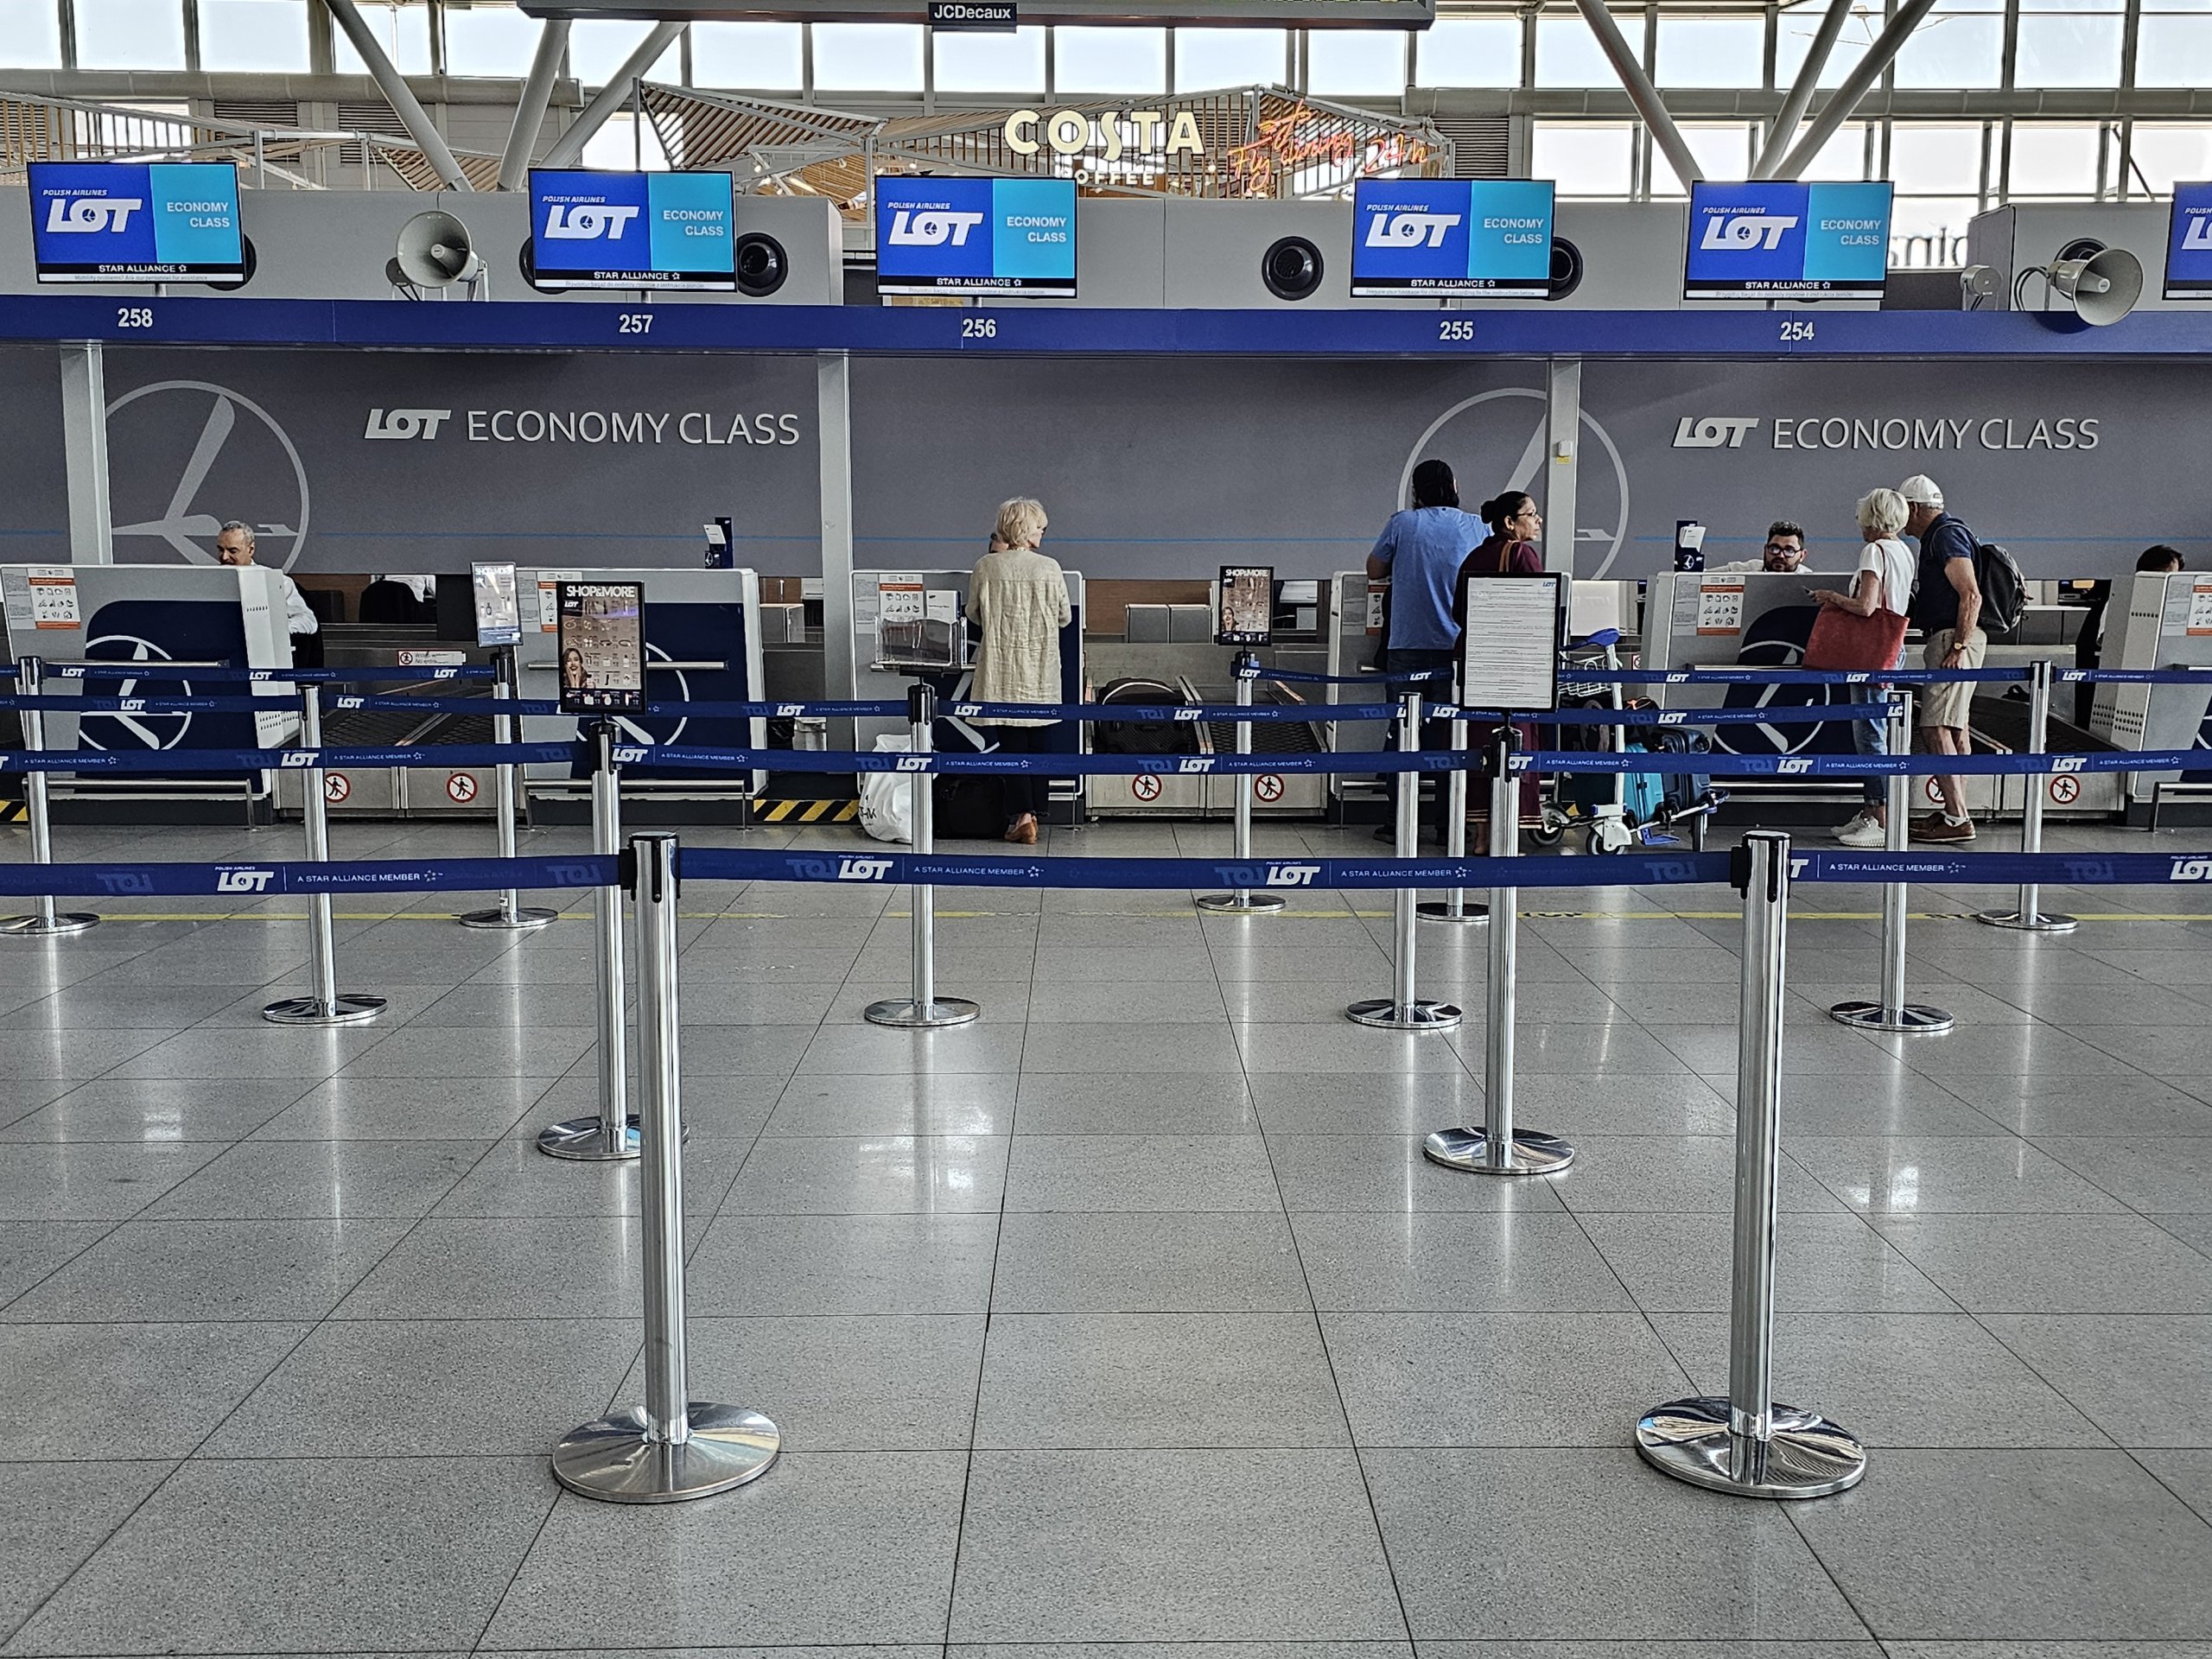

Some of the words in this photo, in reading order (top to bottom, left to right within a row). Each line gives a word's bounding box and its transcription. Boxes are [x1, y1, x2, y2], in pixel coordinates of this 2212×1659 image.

[934, 5, 1011, 19] JCDecaux
[1004, 110, 1206, 162] COSTA
[1058, 168, 1154, 186] OFFEE
[167, 201, 229, 213] ECONOMY
[46, 199, 143, 233] LOT
[663, 210, 723, 221] ECONOMY
[1007, 216, 1067, 227] ECONOMY
[189, 218, 230, 228] CLASS
[543, 205, 639, 239] LOT
[1484, 218, 1544, 229] ECONOMY
[1821, 219, 1882, 230] ECONOMY
[684, 226, 724, 236] CLASS
[887, 211, 984, 246] LOT
[1364, 213, 1462, 248] LOT
[1700, 216, 1799, 250] LOT
[1027, 232, 1066, 243] CLASS
[1503, 233, 1542, 244] CLASS
[1840, 235, 1879, 245] CLASS
[126, 264, 175, 273] ALLIANCE
[594, 271, 619, 280] STAR
[963, 278, 1011, 287] ALLIANCE
[118, 308, 154, 328] 258
[619, 315, 653, 334] 257
[963, 318, 997, 339] 256
[1440, 320, 1474, 340] 255
[1780, 321, 1815, 341] 254
[365, 409, 451, 440] LOT
[467, 410, 671, 443] ECONOMY
[678, 412, 800, 446] CLASS
[1672, 416, 1759, 448] LOT
[1773, 417, 1973, 449] ECONOMY
[1980, 418, 2100, 449] CLASS
[567, 585, 635, 598] SHOP&MORE
[61, 668, 85, 677] LOT
[249, 671, 273, 681] LOT
[434, 669, 458, 678] LOT
[1239, 669, 1261, 677] LOT
[1410, 671, 1433, 681] LOT
[1666, 674, 1690, 683] LOT
[1846, 674, 1870, 683] LOT
[2062, 672, 2087, 681] LOT
[120, 700, 145, 710] LOT
[337, 698, 365, 709] LOT
[777, 705, 805, 716] LOT
[954, 705, 982, 715] LOT
[1173, 709, 1203, 721] LOT
[1433, 707, 1460, 717] LOT
[1887, 706, 1904, 717] LO
[1657, 713, 1687, 724] LOT
[281, 753, 320, 766] LOT
[613, 748, 648, 762] LOT
[896, 758, 932, 771] LOT
[1179, 759, 1215, 772] LOT
[1509, 756, 1533, 769] OT
[1777, 759, 1814, 773] LOT
[2051, 758, 2088, 772] LOT
[837, 859, 893, 880] LOT
[1266, 866, 1321, 885] LOT
[217, 872, 275, 892] LOT
